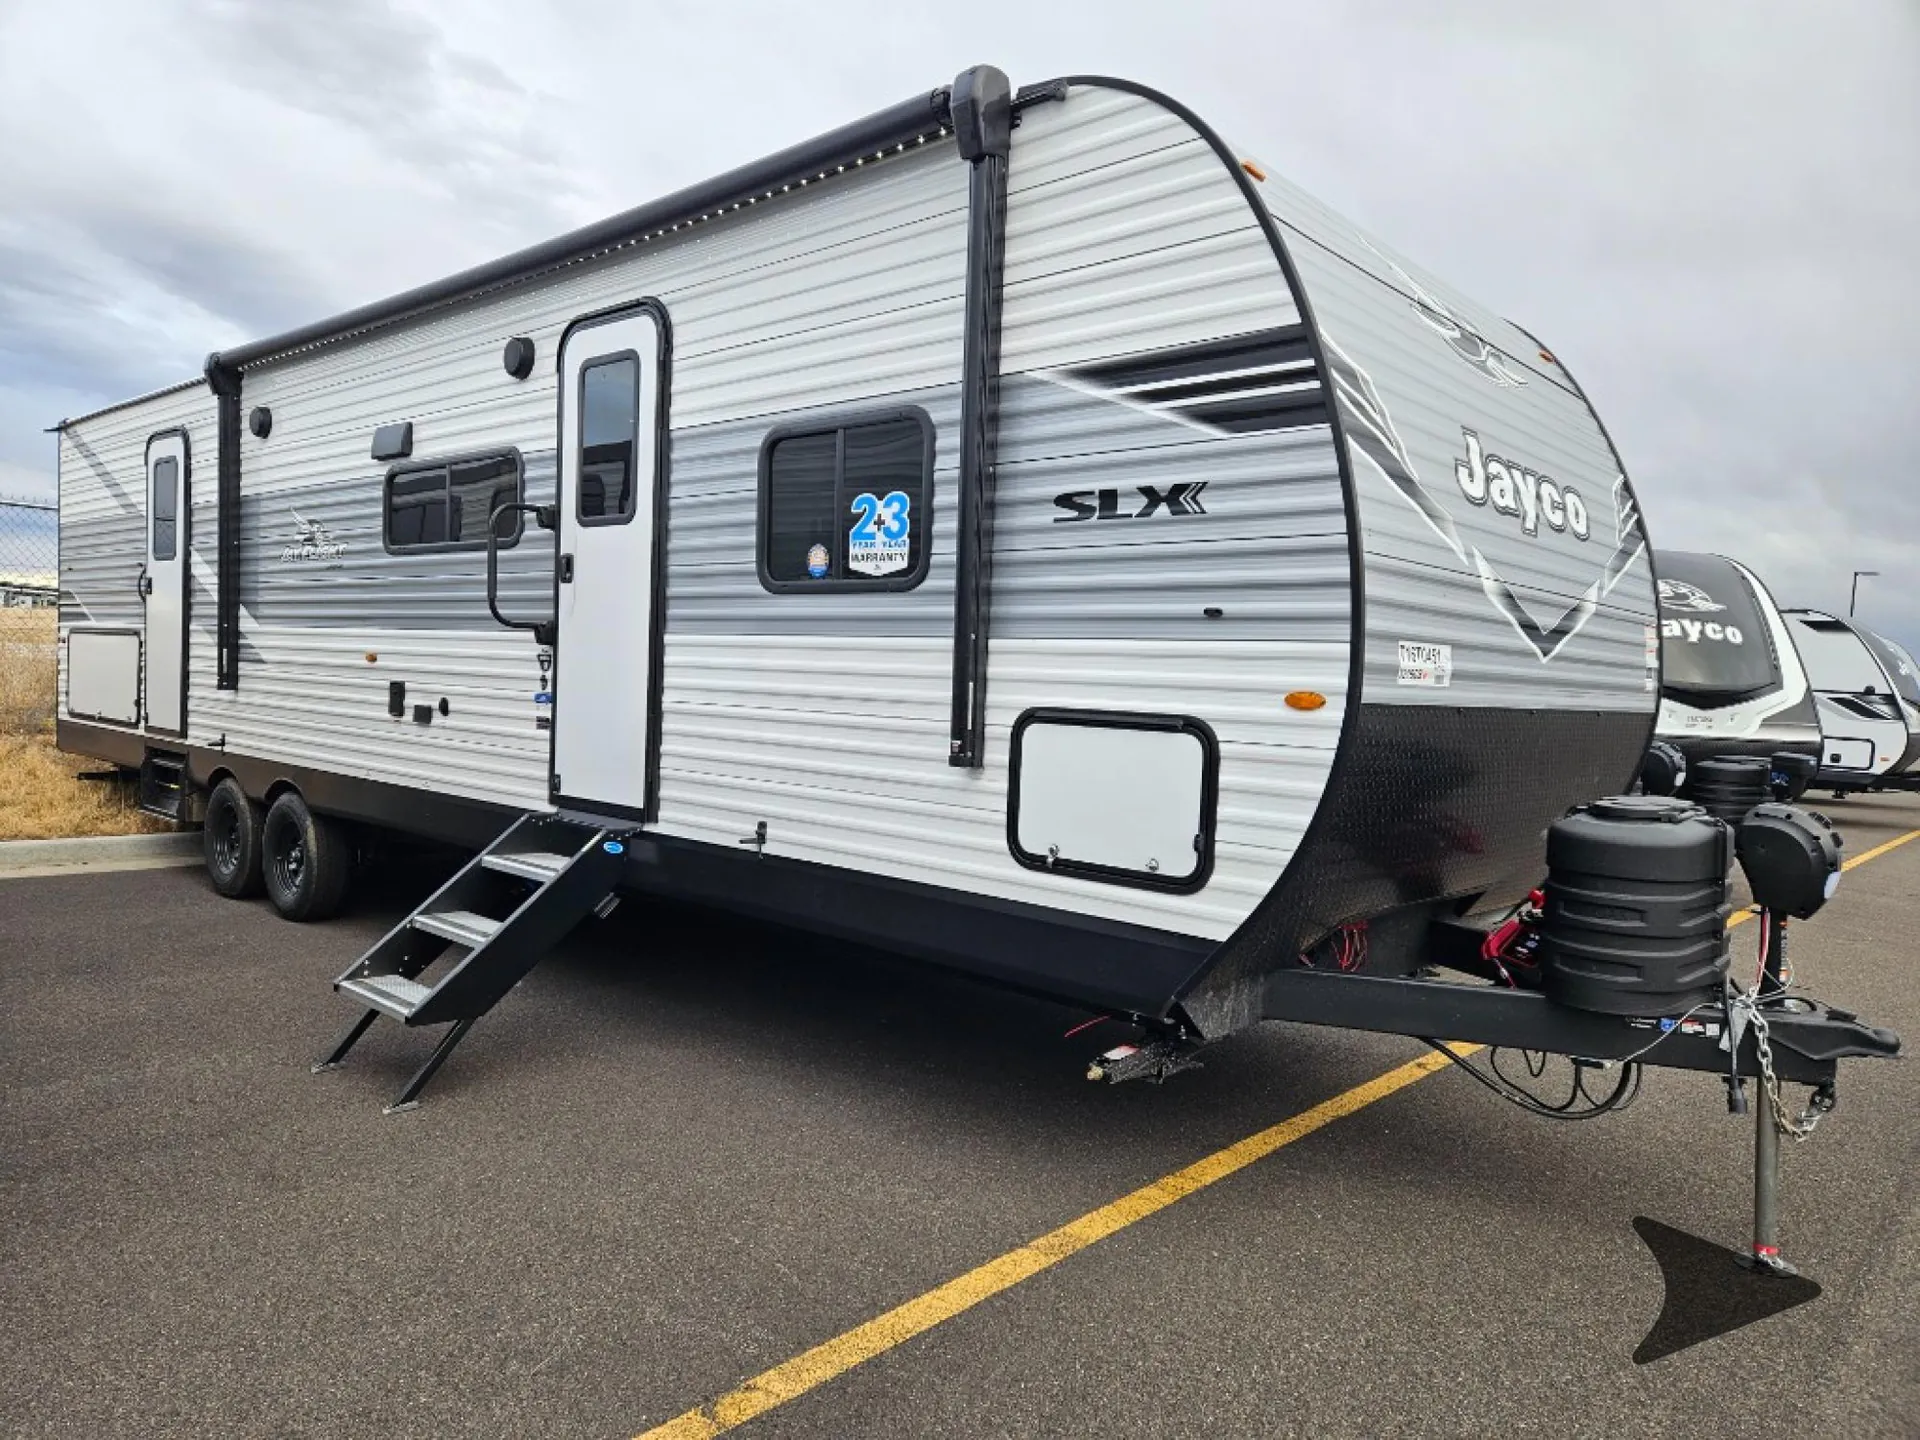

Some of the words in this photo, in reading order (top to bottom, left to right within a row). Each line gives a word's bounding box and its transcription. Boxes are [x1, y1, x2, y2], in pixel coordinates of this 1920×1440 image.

[1455, 427, 1590, 541] Jayco
[1053, 481, 1208, 523] SLX
[851, 552, 906, 563] WARRANTY
[1661, 618, 1743, 645] ayco
